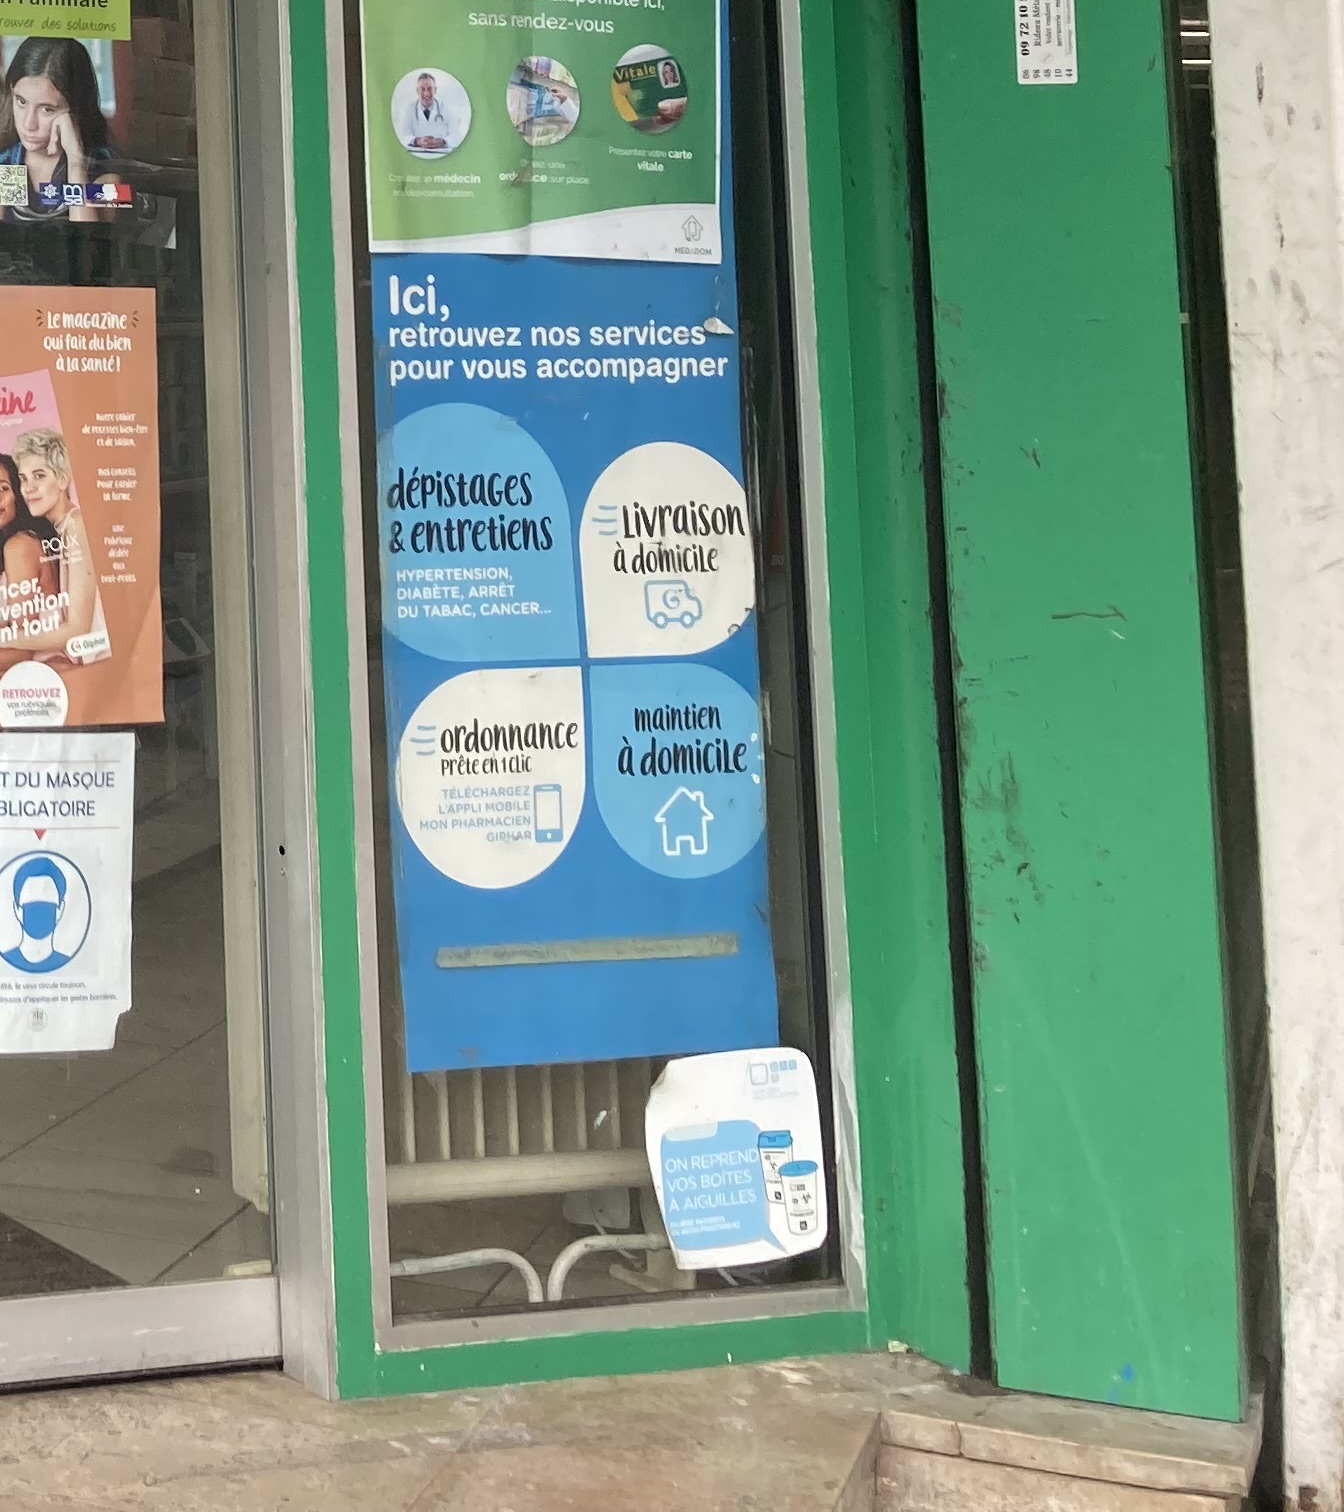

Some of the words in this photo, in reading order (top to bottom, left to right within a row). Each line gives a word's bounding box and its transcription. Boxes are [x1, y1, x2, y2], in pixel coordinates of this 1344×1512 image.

[468, 12, 507, 26] sans
[511, 11, 615, 34] rendez-vous
[1018, 4, 1029, 17] 10
[1019, 21, 1029, 37] 72
[1021, 41, 1030, 56] 09
[388, 274, 451, 322] Ici,
[389, 324, 522, 348] retrouvez
[531, 324, 581, 347] nos
[590, 319, 707, 346] services
[389, 358, 454, 387] pour
[463, 358, 527, 380] vous
[536, 355, 729, 384] accompagner
[388, 525, 407, 554] &
[411, 515, 554, 554] entretiens
[396, 567, 513, 583] HYPERTENSION,
[21, 611, 60, 640] tout
[633, 703, 721, 732] maintien
[440, 717, 579, 754] ordonnance
[617, 736, 635, 777] à
[14, 771, 40, 787] DU
[46, 771, 115, 791] MASQUE
[665, 1157, 689, 1174] ON
[691, 1148, 759, 1170] REPREND
[668, 1175, 698, 1193] VOS
[700, 1168, 753, 1188] BOÎTES
